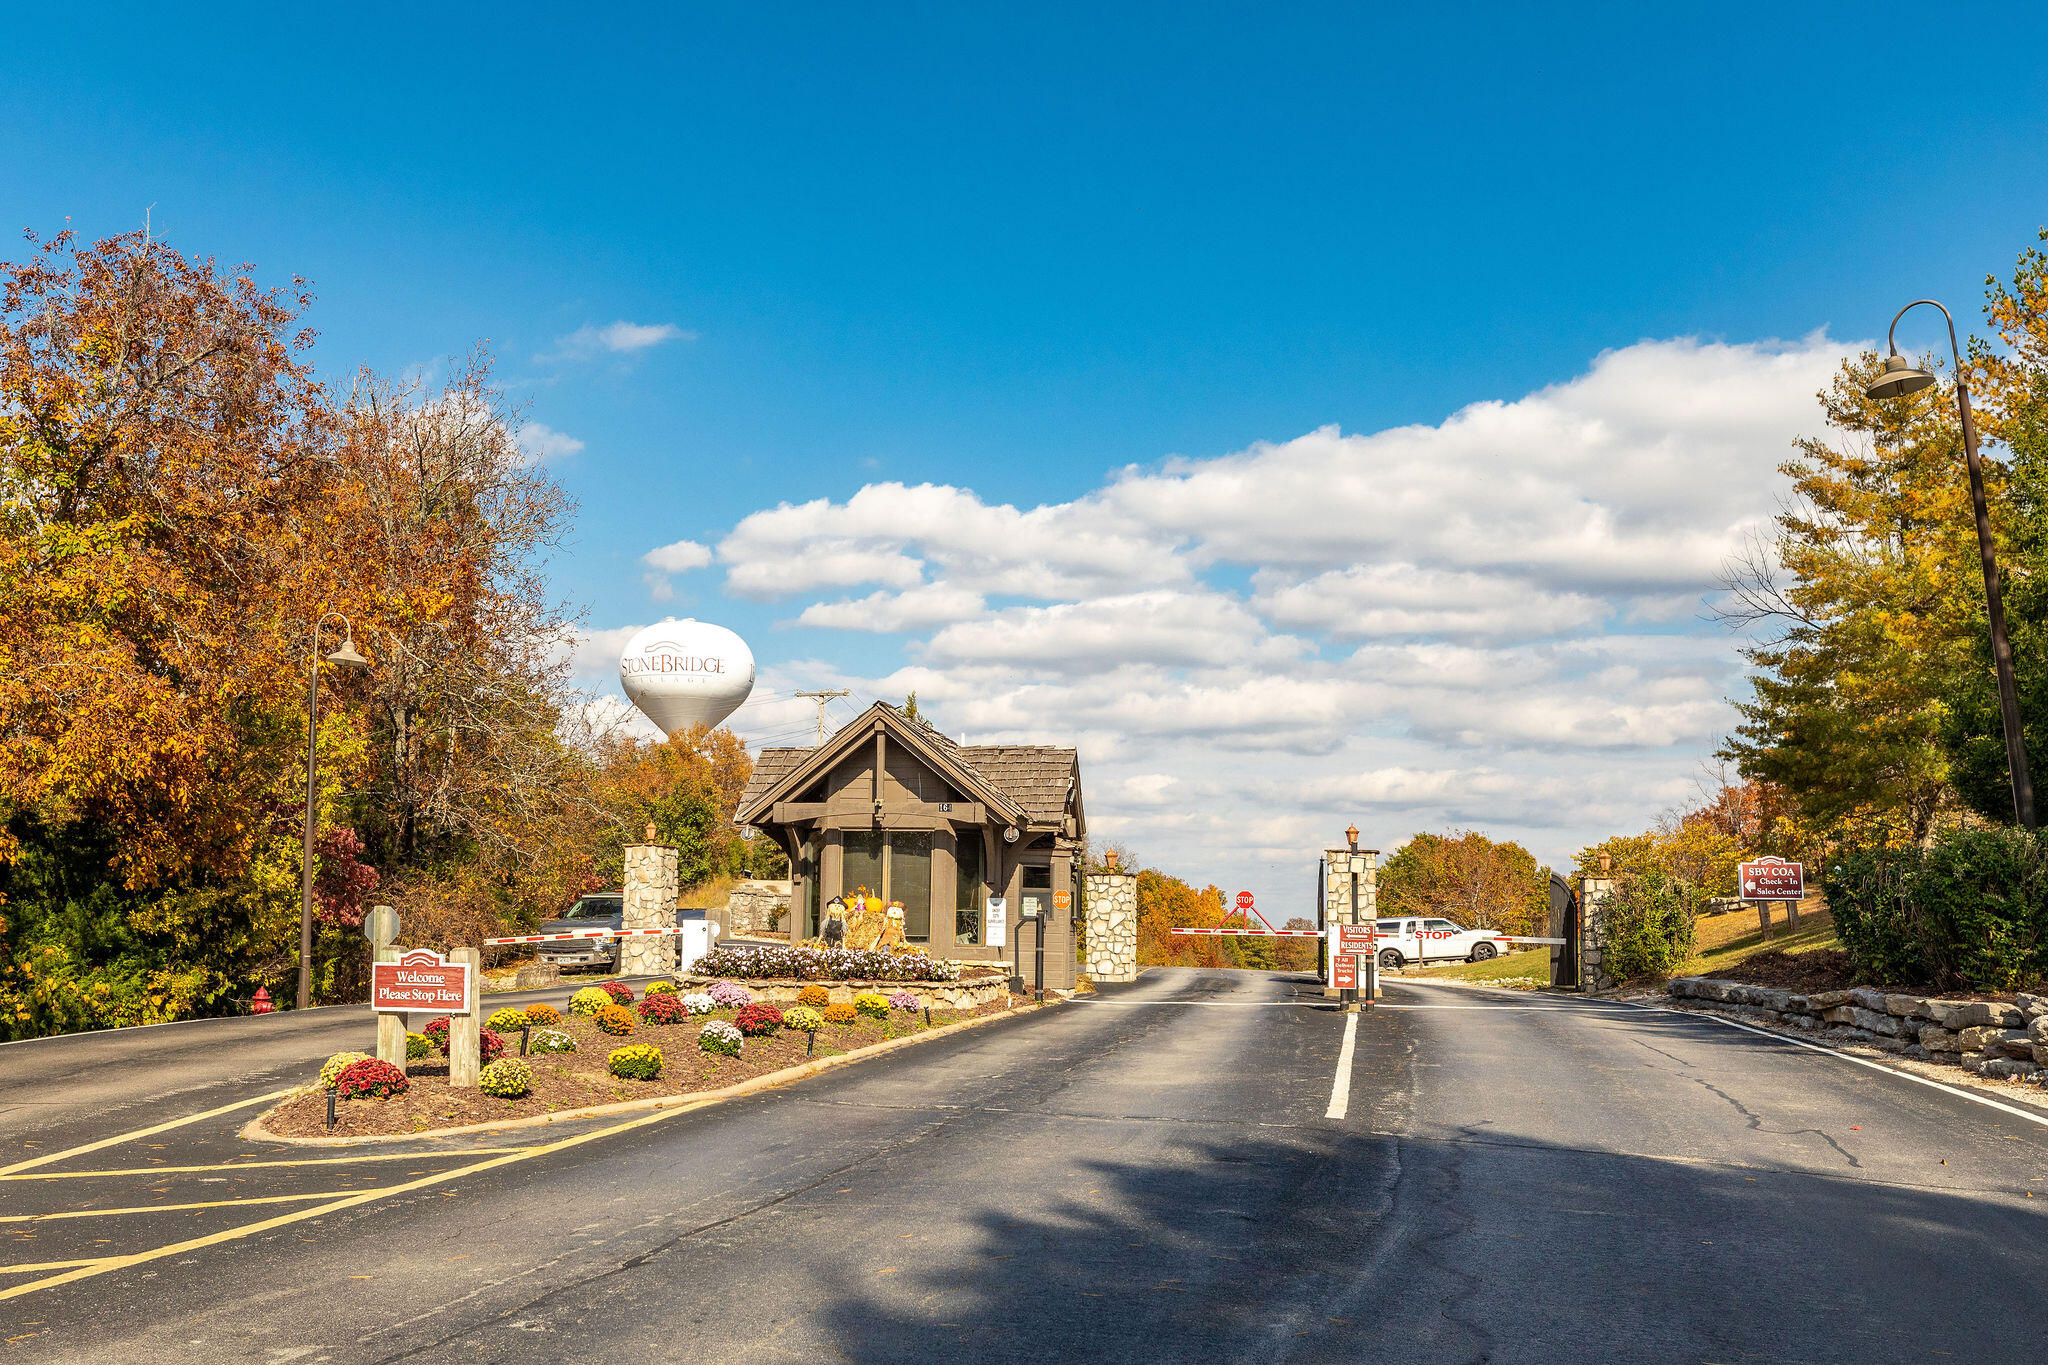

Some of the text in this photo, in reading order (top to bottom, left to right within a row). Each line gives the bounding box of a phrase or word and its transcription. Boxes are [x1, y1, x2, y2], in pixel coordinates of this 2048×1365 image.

[1748, 867, 1796, 877] SBV COA
[1759, 877, 1783, 885] Check
[1789, 877, 1798, 885] In
[1756, 887, 1802, 895] Sales Center
[1054, 896, 1071, 904] STOP
[1236, 896, 1254, 904] STOP
[1342, 925, 1371, 934] VISITORS
[1415, 930, 1452, 940] STOP
[1340, 941, 1373, 949] RESIDENTS
[396, 970, 446, 984] Welcome
[378, 986, 463, 1003] Please Stop Here
